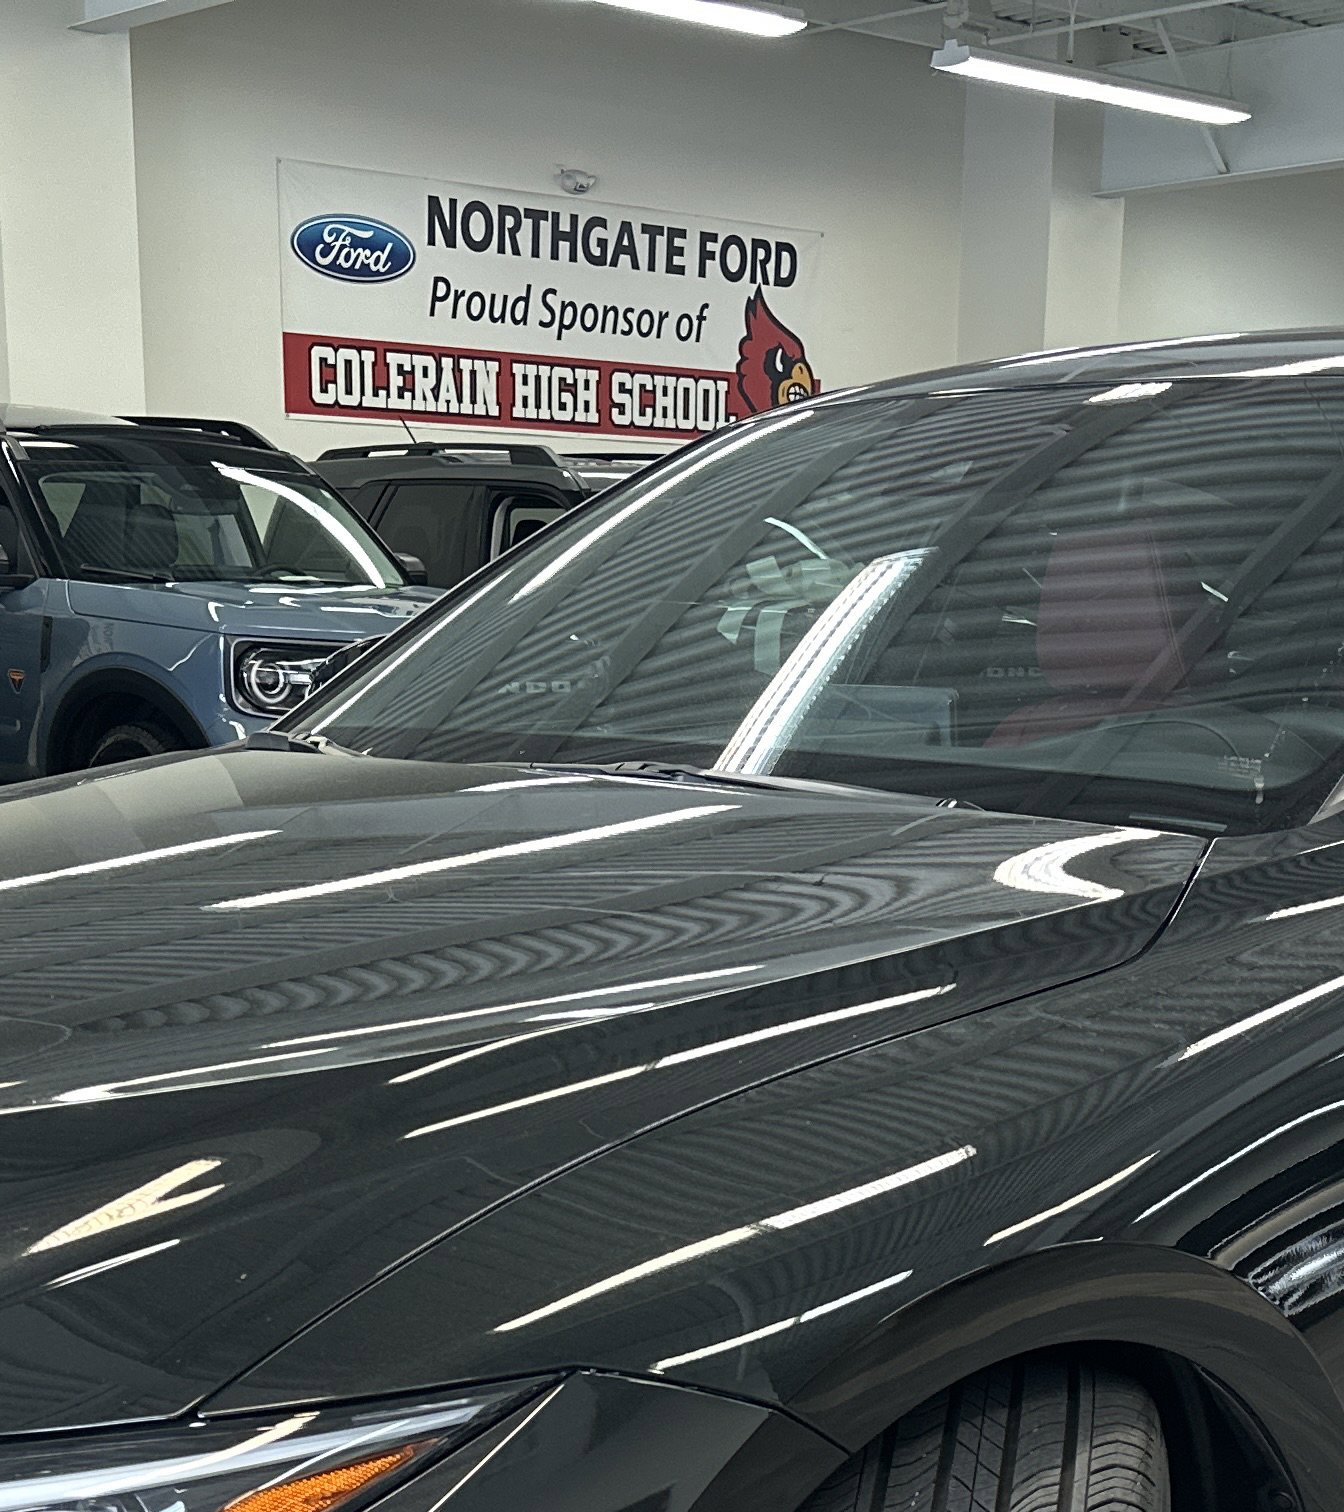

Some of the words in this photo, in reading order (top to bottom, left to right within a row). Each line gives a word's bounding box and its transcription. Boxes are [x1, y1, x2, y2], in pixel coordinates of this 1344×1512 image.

[315, 223, 393, 273] Ford
[426, 194, 688, 277] NORTHGATE
[697, 230, 798, 288] FORD
[429, 276, 532, 326] Proud
[538, 287, 670, 341] Sponsor
[675, 302, 710, 343] of
[309, 345, 501, 417] COLERAIN
[512, 362, 600, 424] HIGH
[610, 371, 737, 431] SCHOOL
